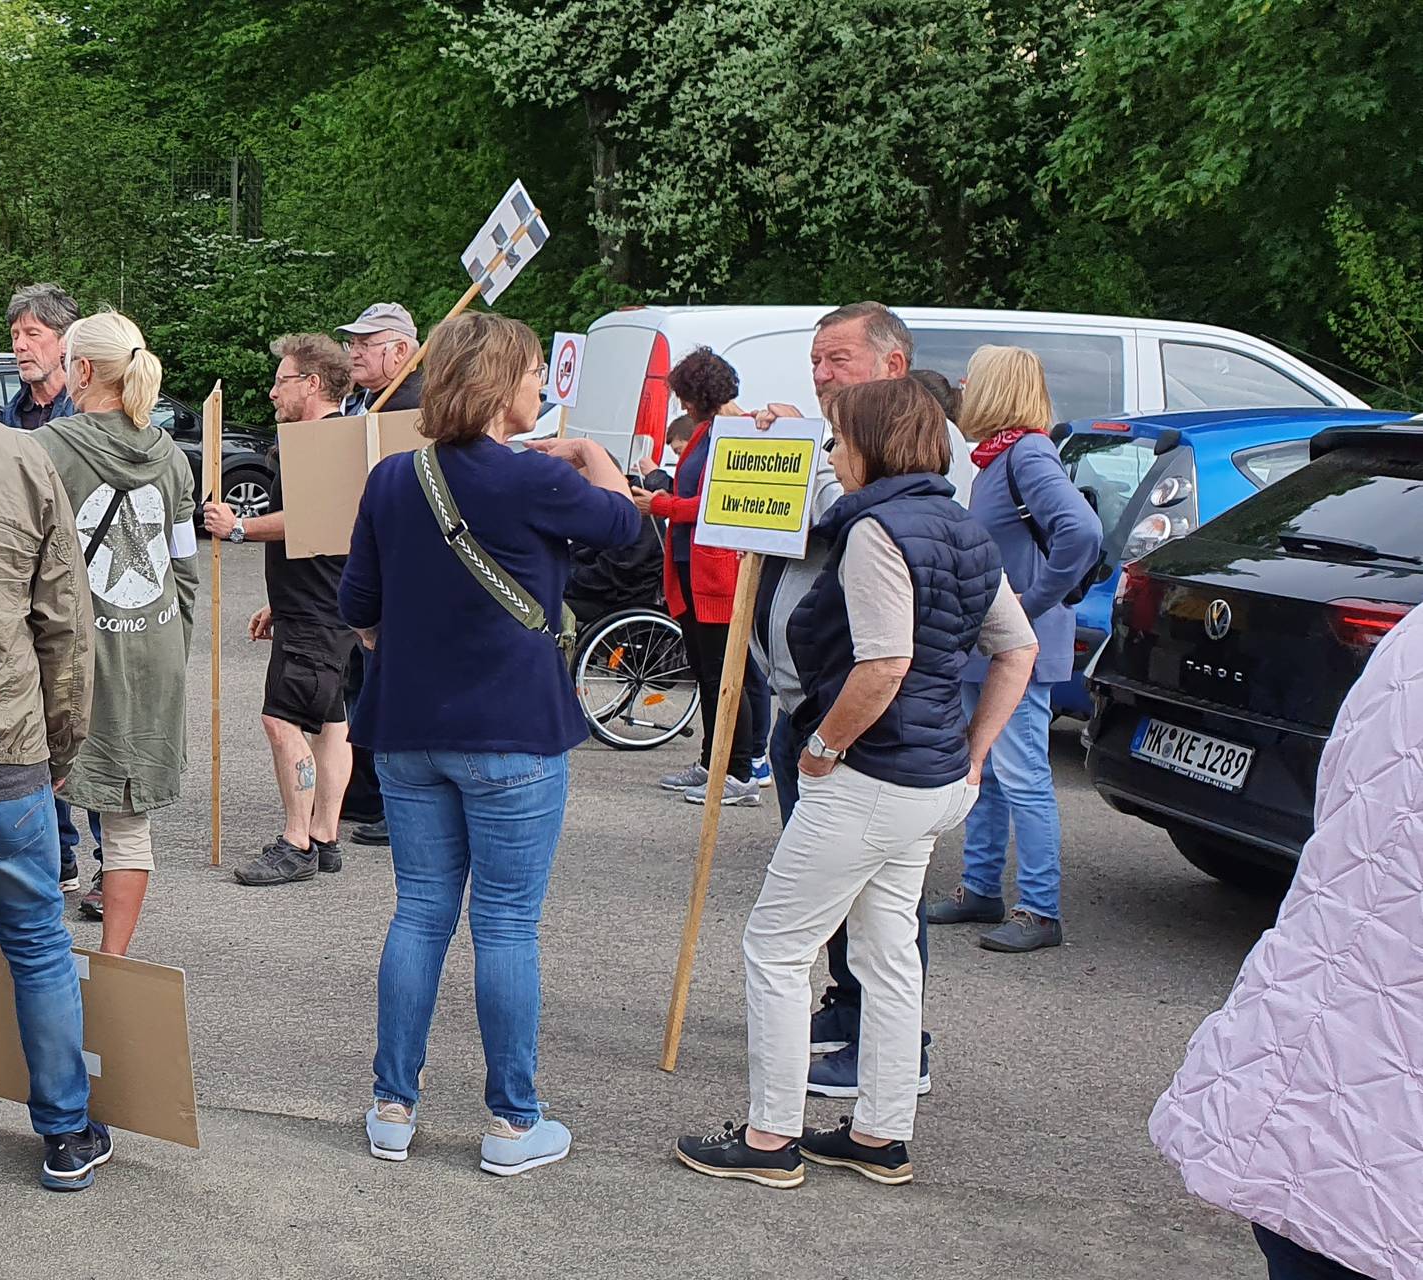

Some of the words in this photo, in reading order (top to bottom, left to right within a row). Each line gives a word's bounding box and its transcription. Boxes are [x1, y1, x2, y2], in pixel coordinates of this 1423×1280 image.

[726, 450, 802, 473] Lüdenscheid
[722, 494, 765, 514] Lkw-freie
[766, 498, 791, 516] Zone
[1142, 724, 1169, 755] MK
[1172, 732, 1202, 766] KE
[1197, 741, 1248, 780] 1289
